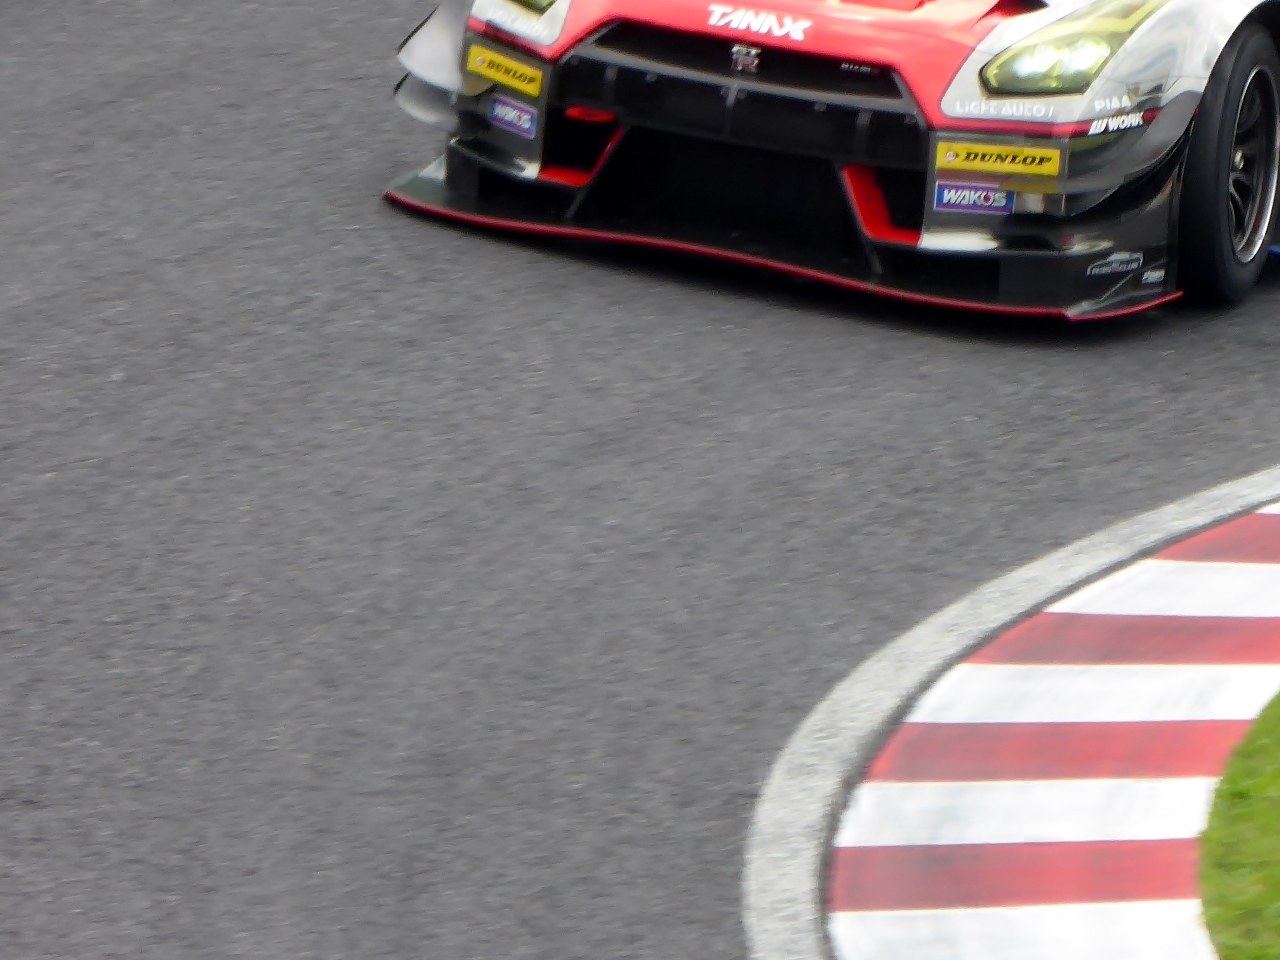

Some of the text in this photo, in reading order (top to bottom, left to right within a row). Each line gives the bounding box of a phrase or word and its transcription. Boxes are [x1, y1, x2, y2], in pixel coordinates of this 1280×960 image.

[707, 3, 813, 41] TANAX
[1094, 95, 1131, 112] PIAA
[1105, 112, 1145, 133] WORK
[961, 151, 1052, 167] DUNLOP
